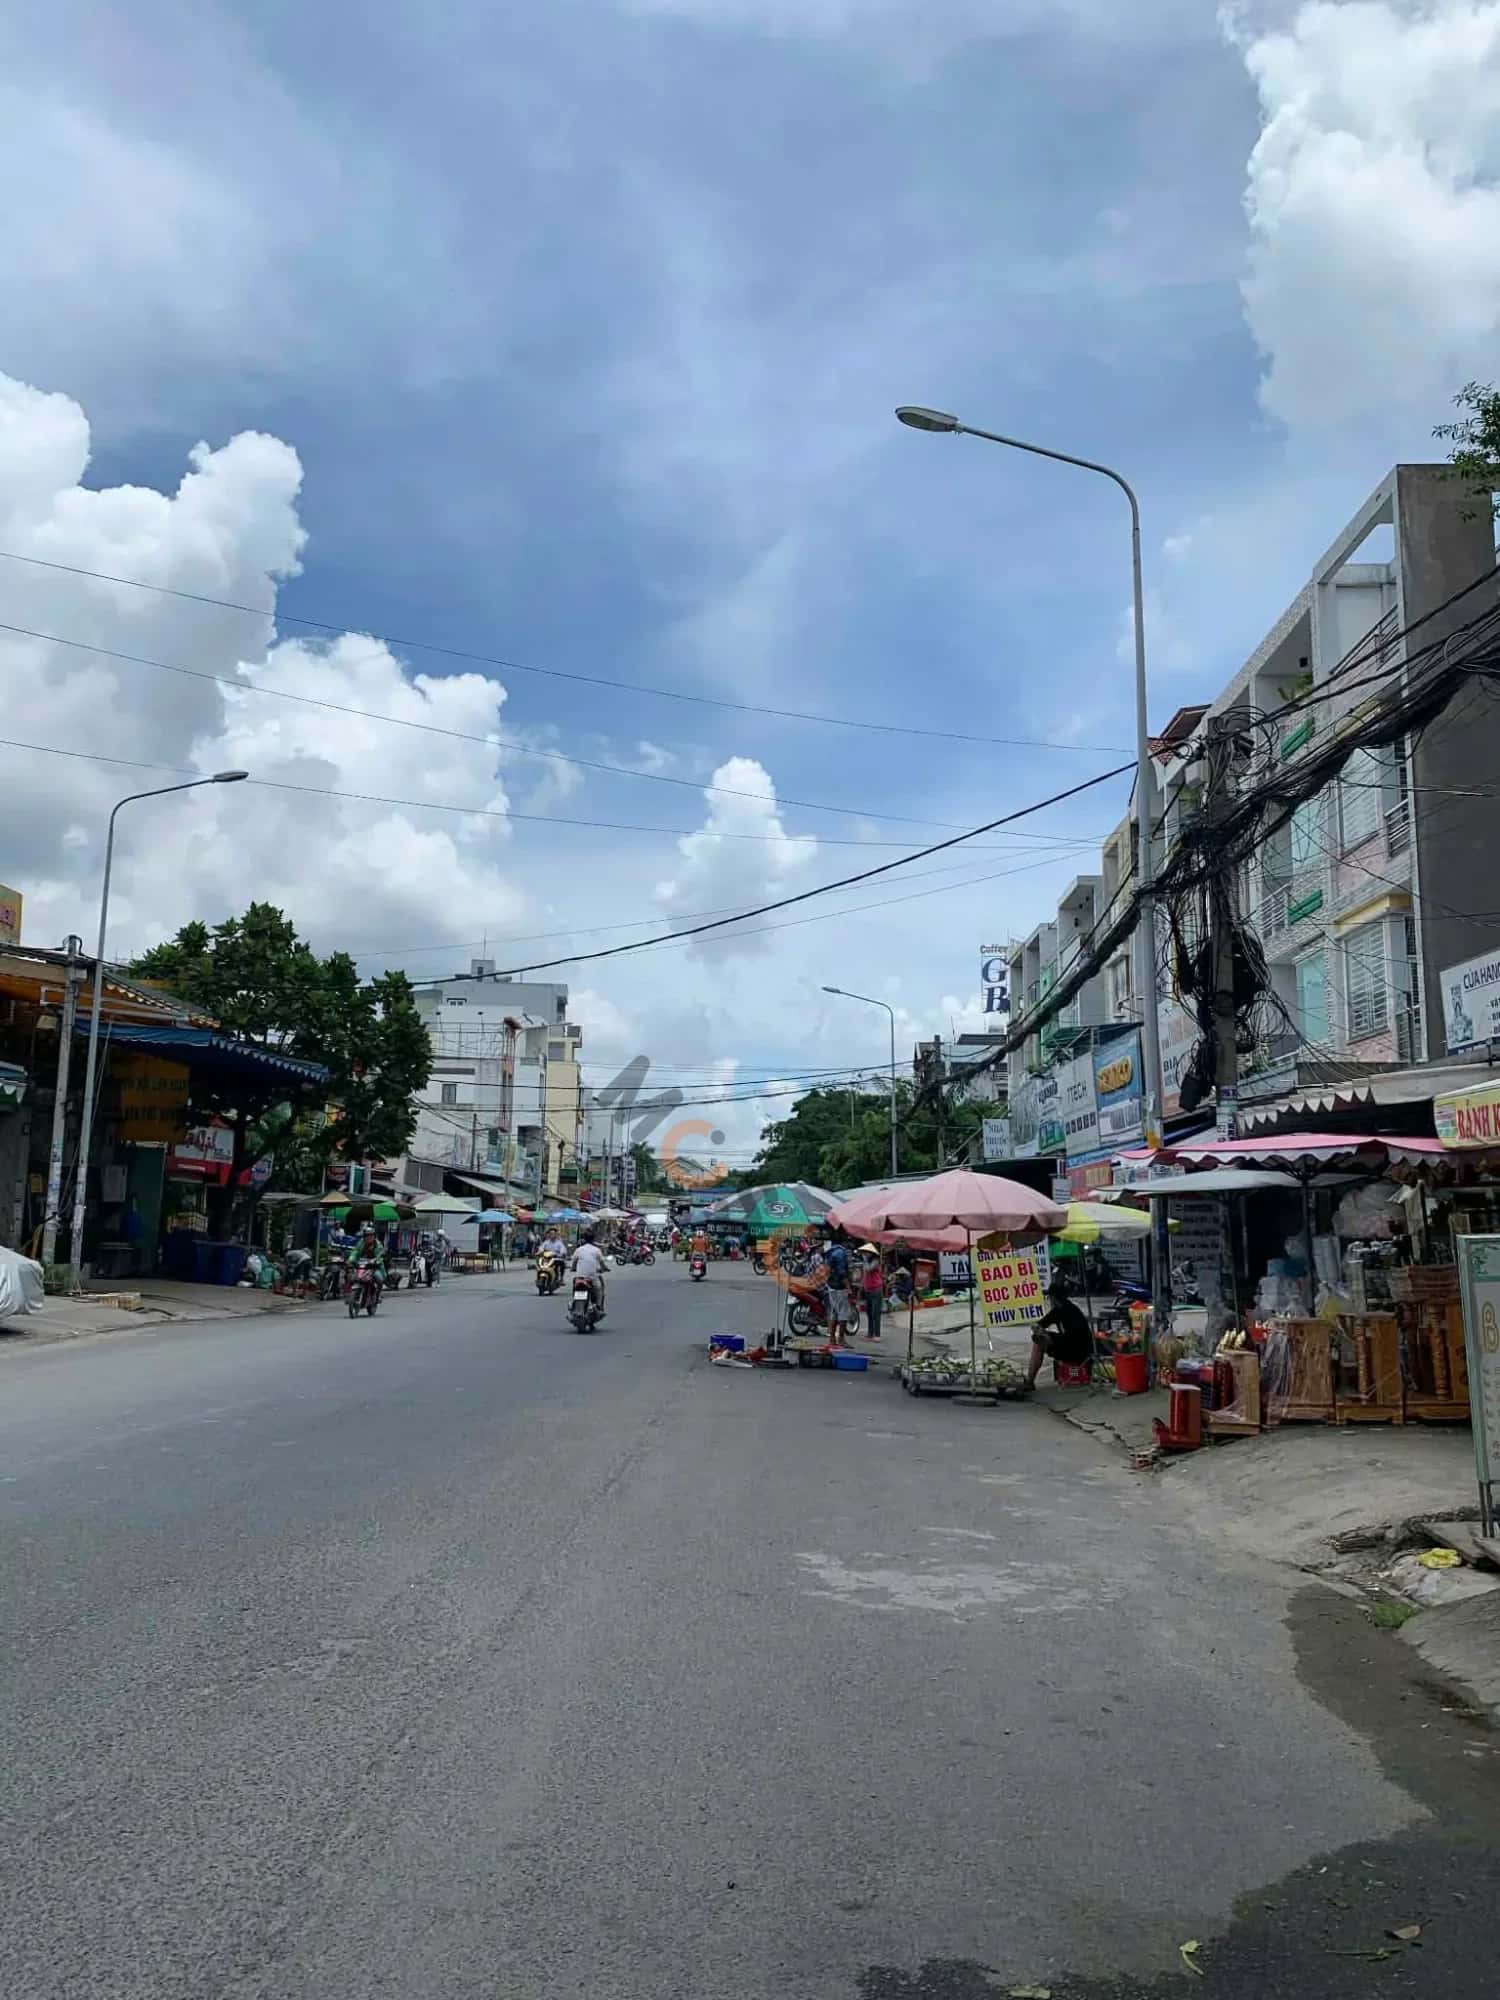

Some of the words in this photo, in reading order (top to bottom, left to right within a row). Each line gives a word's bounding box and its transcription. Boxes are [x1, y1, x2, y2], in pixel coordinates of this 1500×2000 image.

[981, 1264, 1013, 1281] BAO
[983, 1286, 1010, 1305] BỌC
[1013, 1278, 1038, 1299] XỐP
